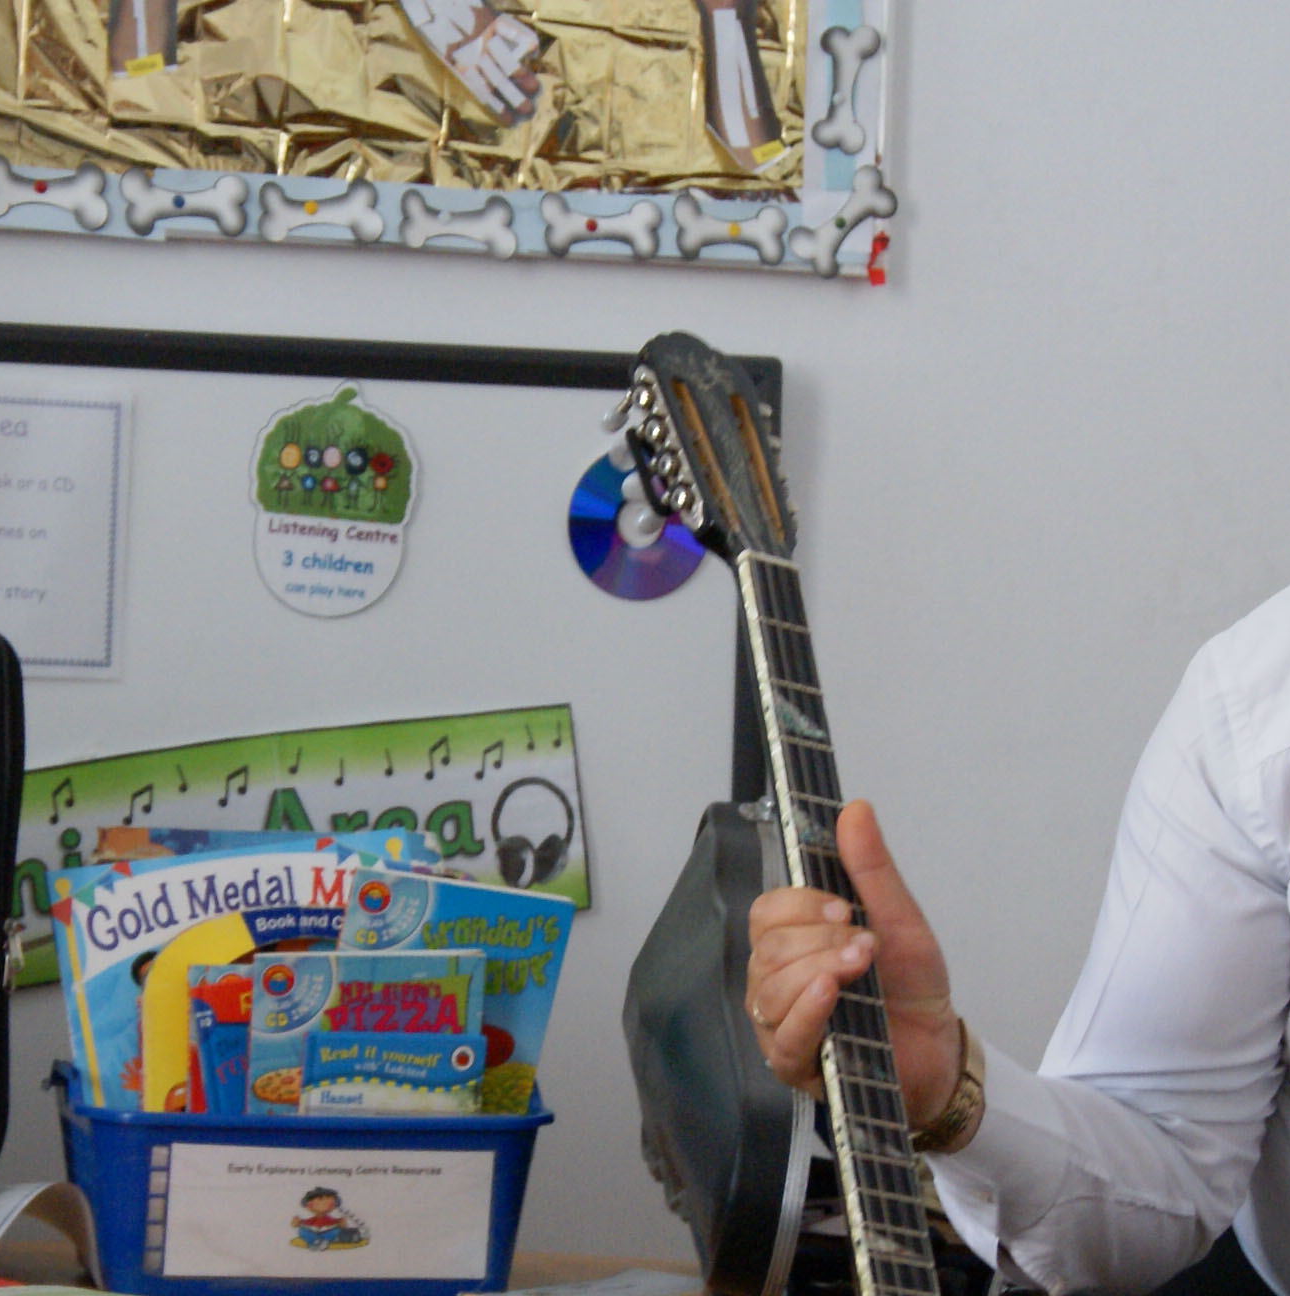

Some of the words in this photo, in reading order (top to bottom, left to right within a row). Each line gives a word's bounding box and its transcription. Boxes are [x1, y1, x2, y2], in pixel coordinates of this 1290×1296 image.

[16, 477, 34, 491] or
[37, 478, 48, 491] a
[52, 477, 75, 493] CD
[28, 527, 48, 540] on
[268, 519, 339, 543] Listening
[345, 525, 398, 545] Centre
[282, 549, 294, 568] 3
[301, 551, 374, 575] children
[4, 584, 46, 603] story
[86, 882, 179, 952] Gold
[183, 865, 298, 920] Medal
[255, 913, 296, 932] Book
[299, 913, 329, 928] and
[332, 914, 343, 928] C
[265, 1012, 289, 1027] CD
[323, 993, 463, 1034] PIZZA
[319, 1044, 359, 1064] Read
[364, 1045, 378, 1060] it
[226, 1163, 253, 1176] Early
[256, 1164, 306, 1177] Explorers
